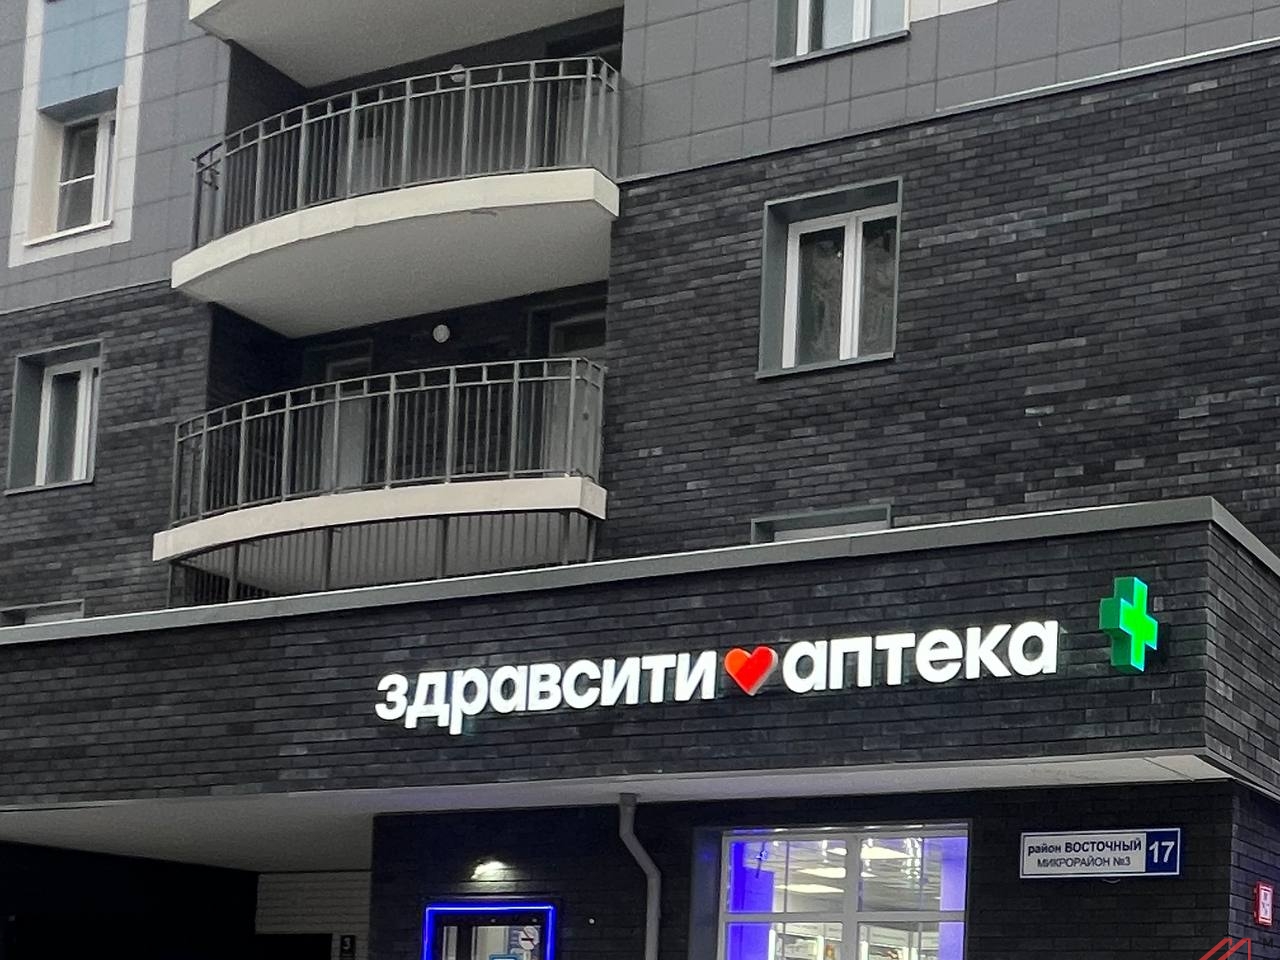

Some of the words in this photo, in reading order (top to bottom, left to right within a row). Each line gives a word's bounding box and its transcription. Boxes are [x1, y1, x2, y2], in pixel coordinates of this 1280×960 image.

[374, 650, 718, 735] здравсити
[782, 620, 1059, 694] аптека
[1028, 842, 1061, 856] район
[1065, 838, 1142, 853] ВОСТОЧНЫЙ
[1149, 841, 1175, 863] 17
[1037, 856, 1110, 868] МИКРОРАЙОН
